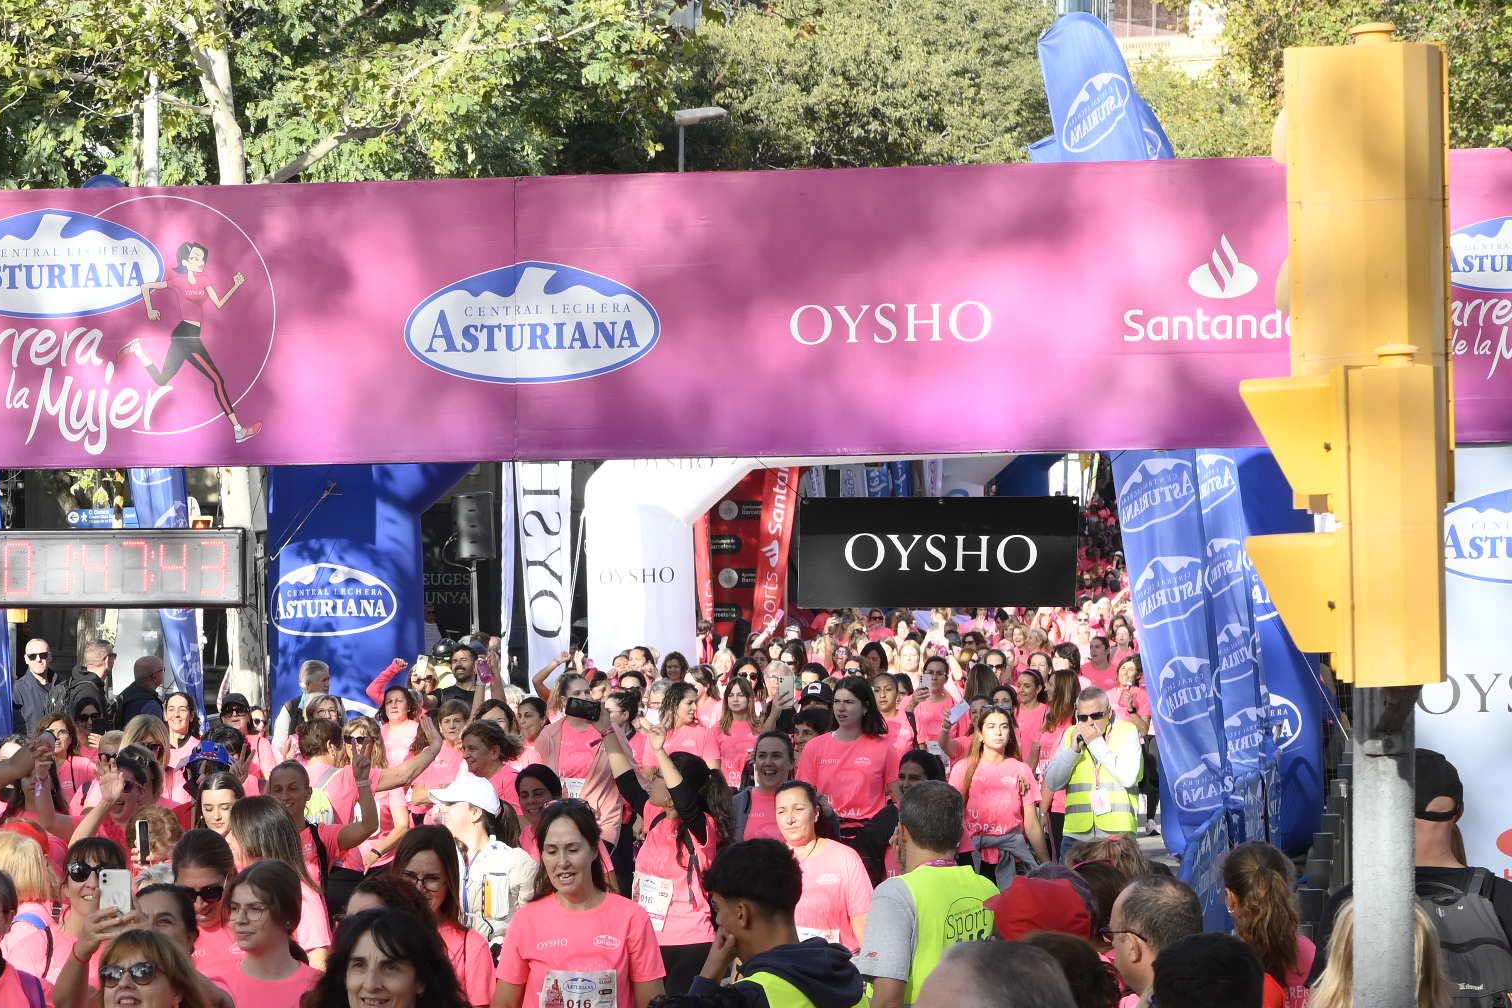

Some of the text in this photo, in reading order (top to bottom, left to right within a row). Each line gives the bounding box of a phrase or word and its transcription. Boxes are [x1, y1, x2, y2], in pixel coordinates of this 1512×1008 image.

[463, 302, 632, 318] CENTRAL LECHERA
[789, 300, 993, 346] OYSHO
[425, 309, 641, 353] ASTURIANA
[5, 370, 29, 410] la
[25, 362, 174, 455] Mujer
[843, 532, 1038, 574] OYSHO
[286, 588, 329, 597] CENTRAL
[598, 565, 676, 586] OYSHO
[274, 592, 389, 621] ASTURIANA
